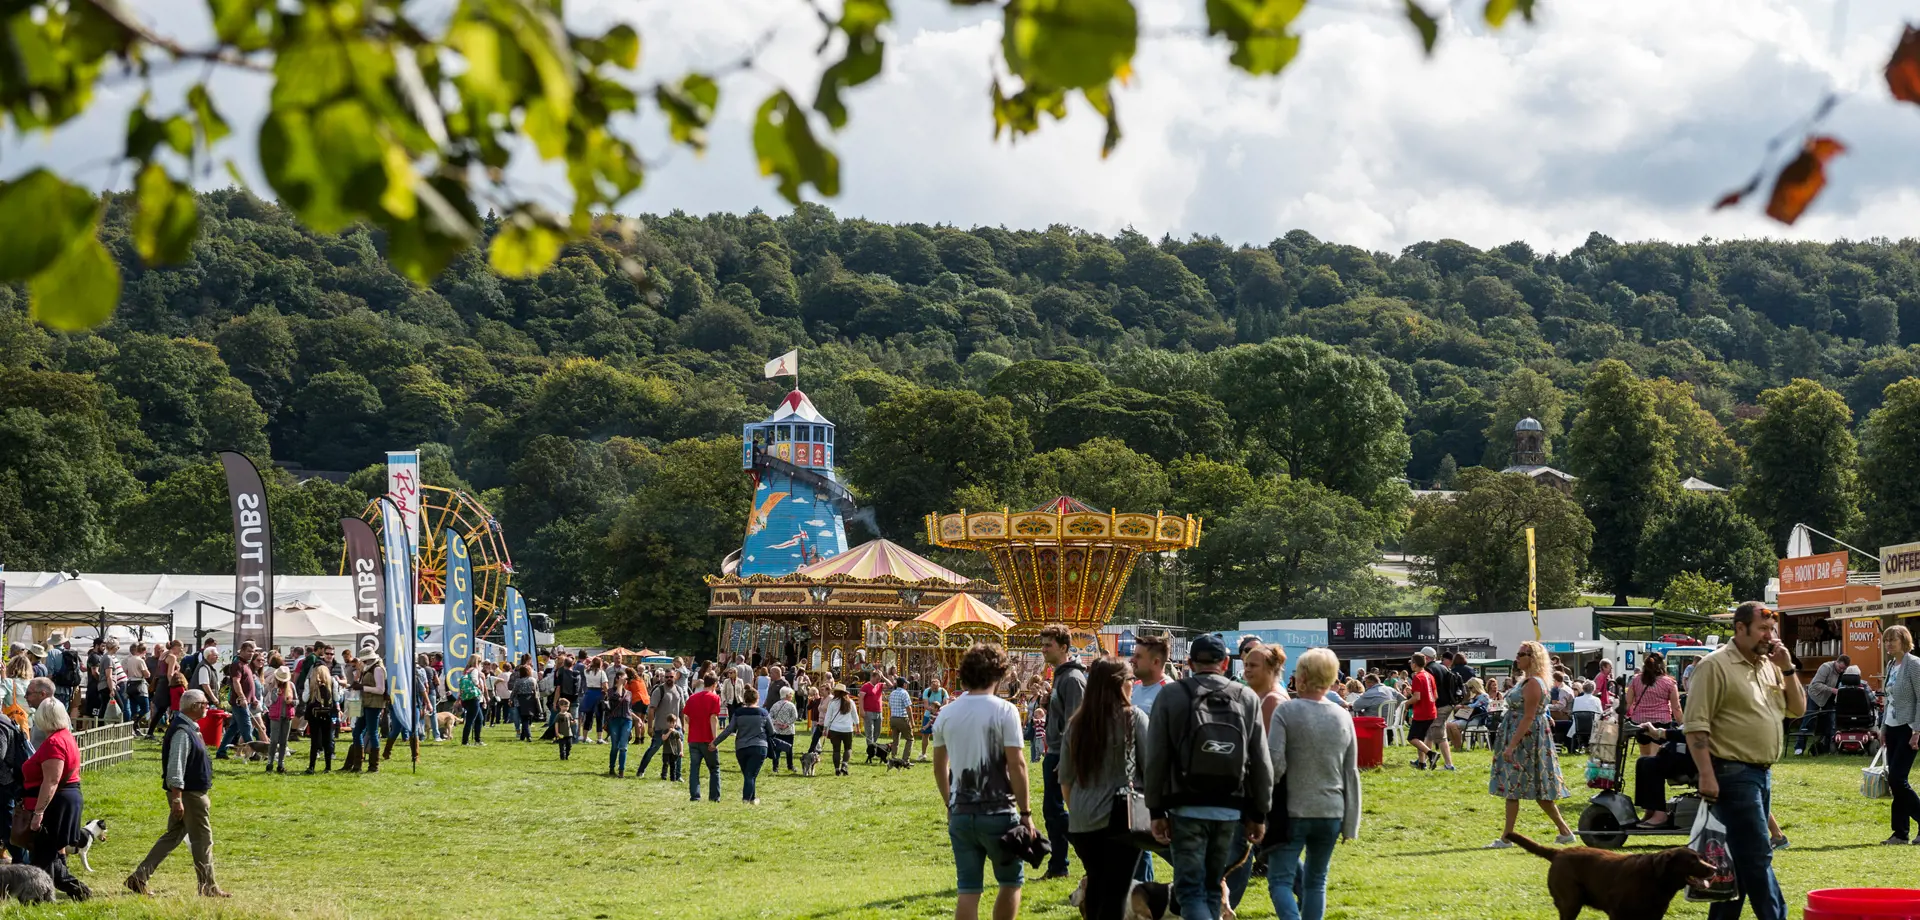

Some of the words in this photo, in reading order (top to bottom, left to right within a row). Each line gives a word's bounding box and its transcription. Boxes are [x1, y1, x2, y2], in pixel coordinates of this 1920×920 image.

[1794, 563, 1816, 582] HOOKY
[1817, 561, 1830, 580] BAR
[1353, 622, 1412, 639] #BURGERBAR
[1855, 621, 1874, 629] CRAFTY
[1284, 632, 1307, 644] The
[1849, 632, 1874, 642] HOOKY?
